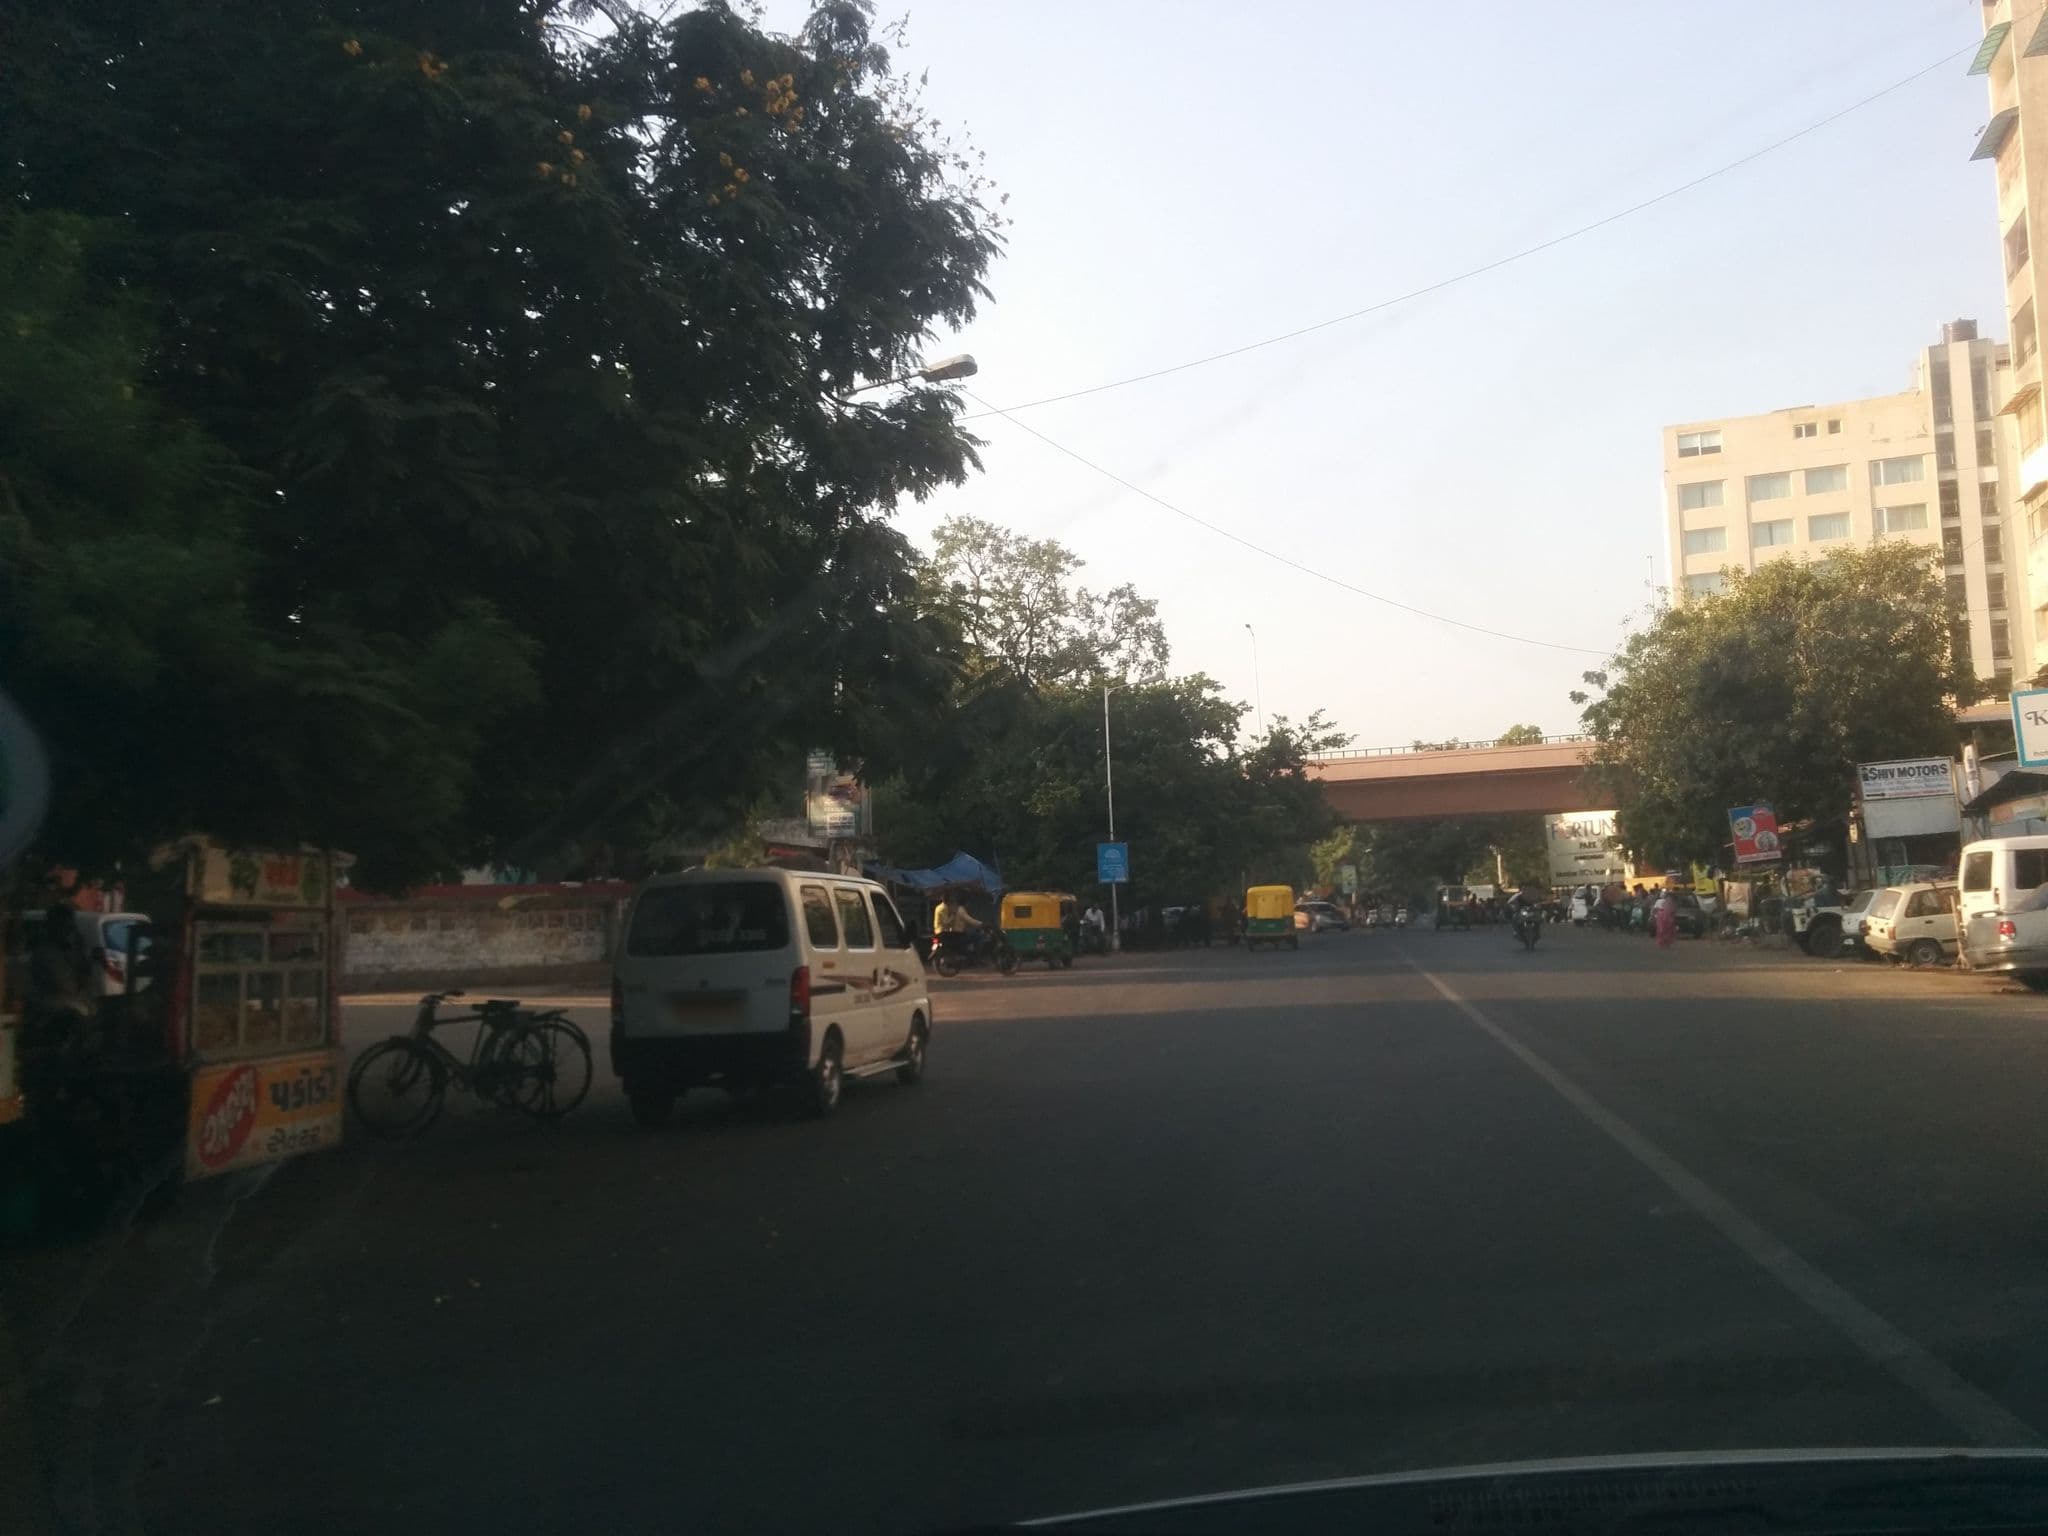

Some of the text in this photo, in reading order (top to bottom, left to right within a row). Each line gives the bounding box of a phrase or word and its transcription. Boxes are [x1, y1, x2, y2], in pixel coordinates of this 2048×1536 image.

[1868, 763, 1948, 781] SHIV MOTORS
[1551, 817, 1616, 841] FORTUN
